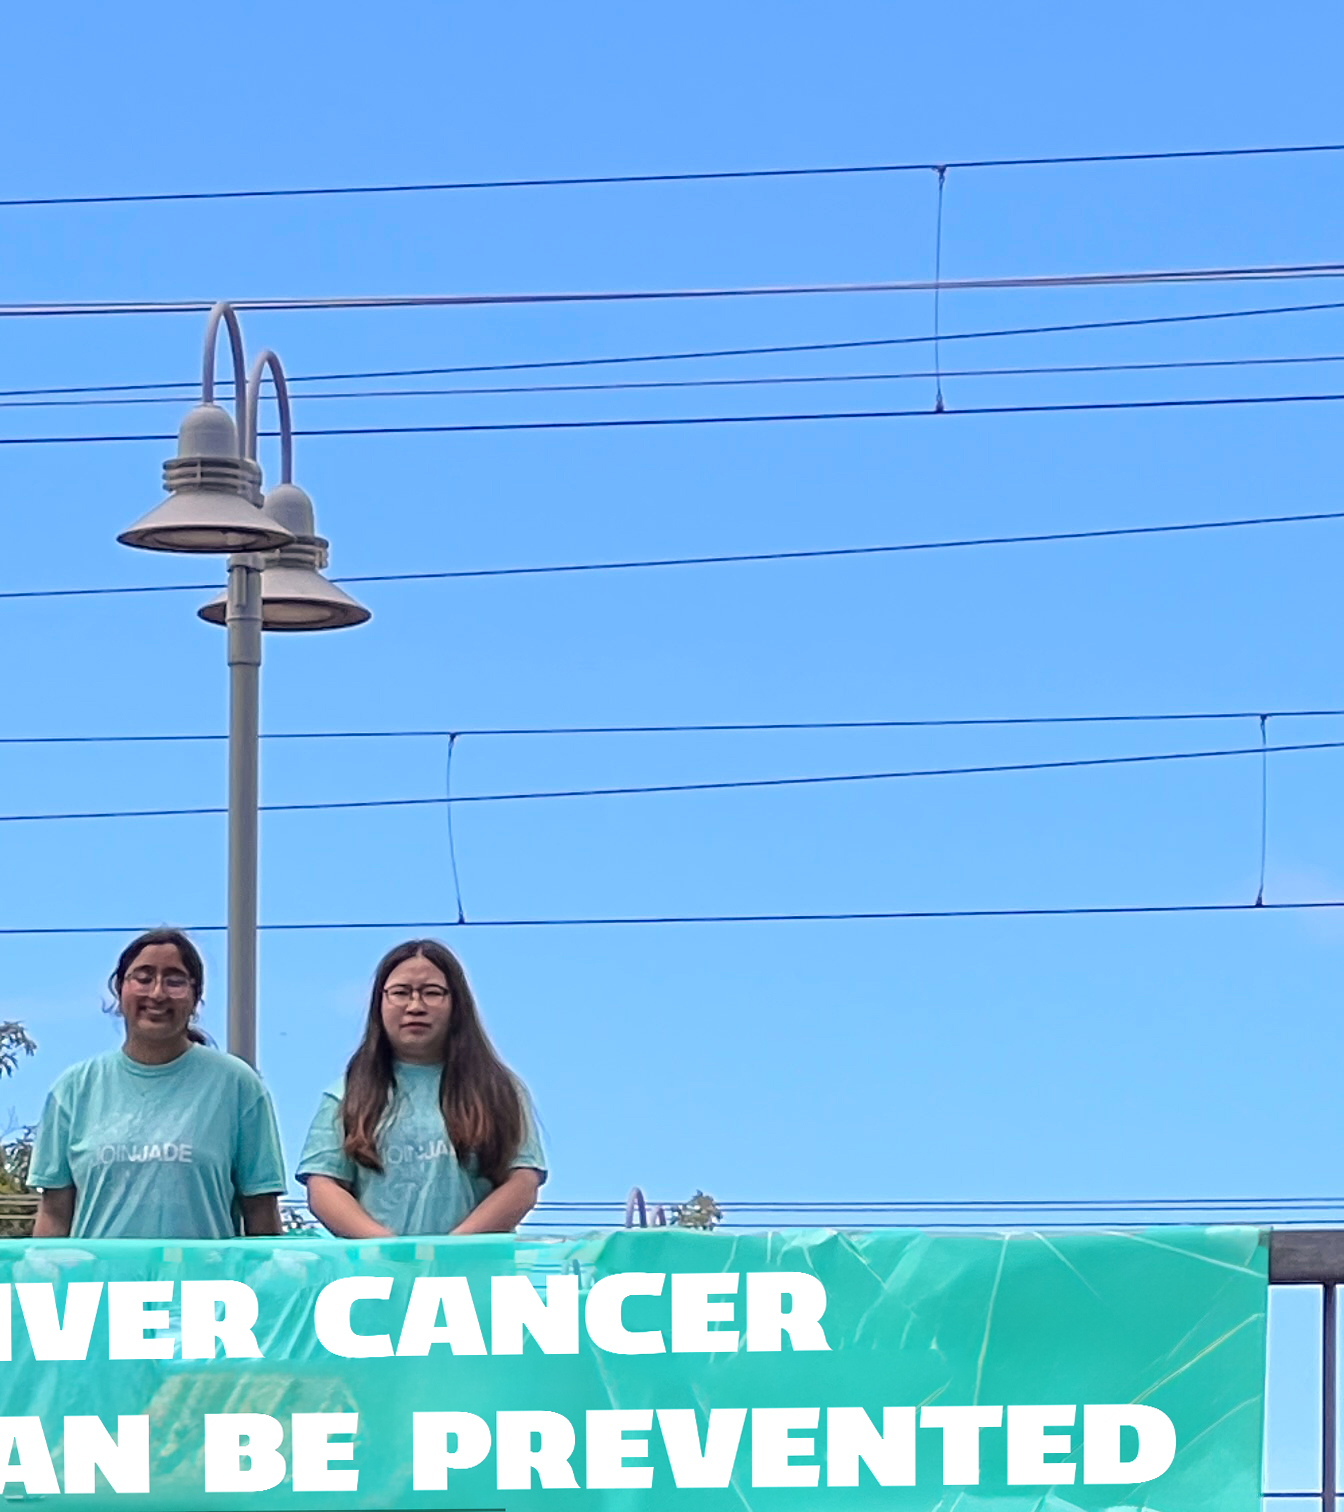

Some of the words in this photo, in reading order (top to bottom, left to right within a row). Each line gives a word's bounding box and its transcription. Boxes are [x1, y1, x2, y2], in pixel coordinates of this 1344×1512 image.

[313, 1270, 831, 1359] CANCER
[203, 1411, 360, 1493] BE
[411, 1402, 1179, 1491] PREVENTED
